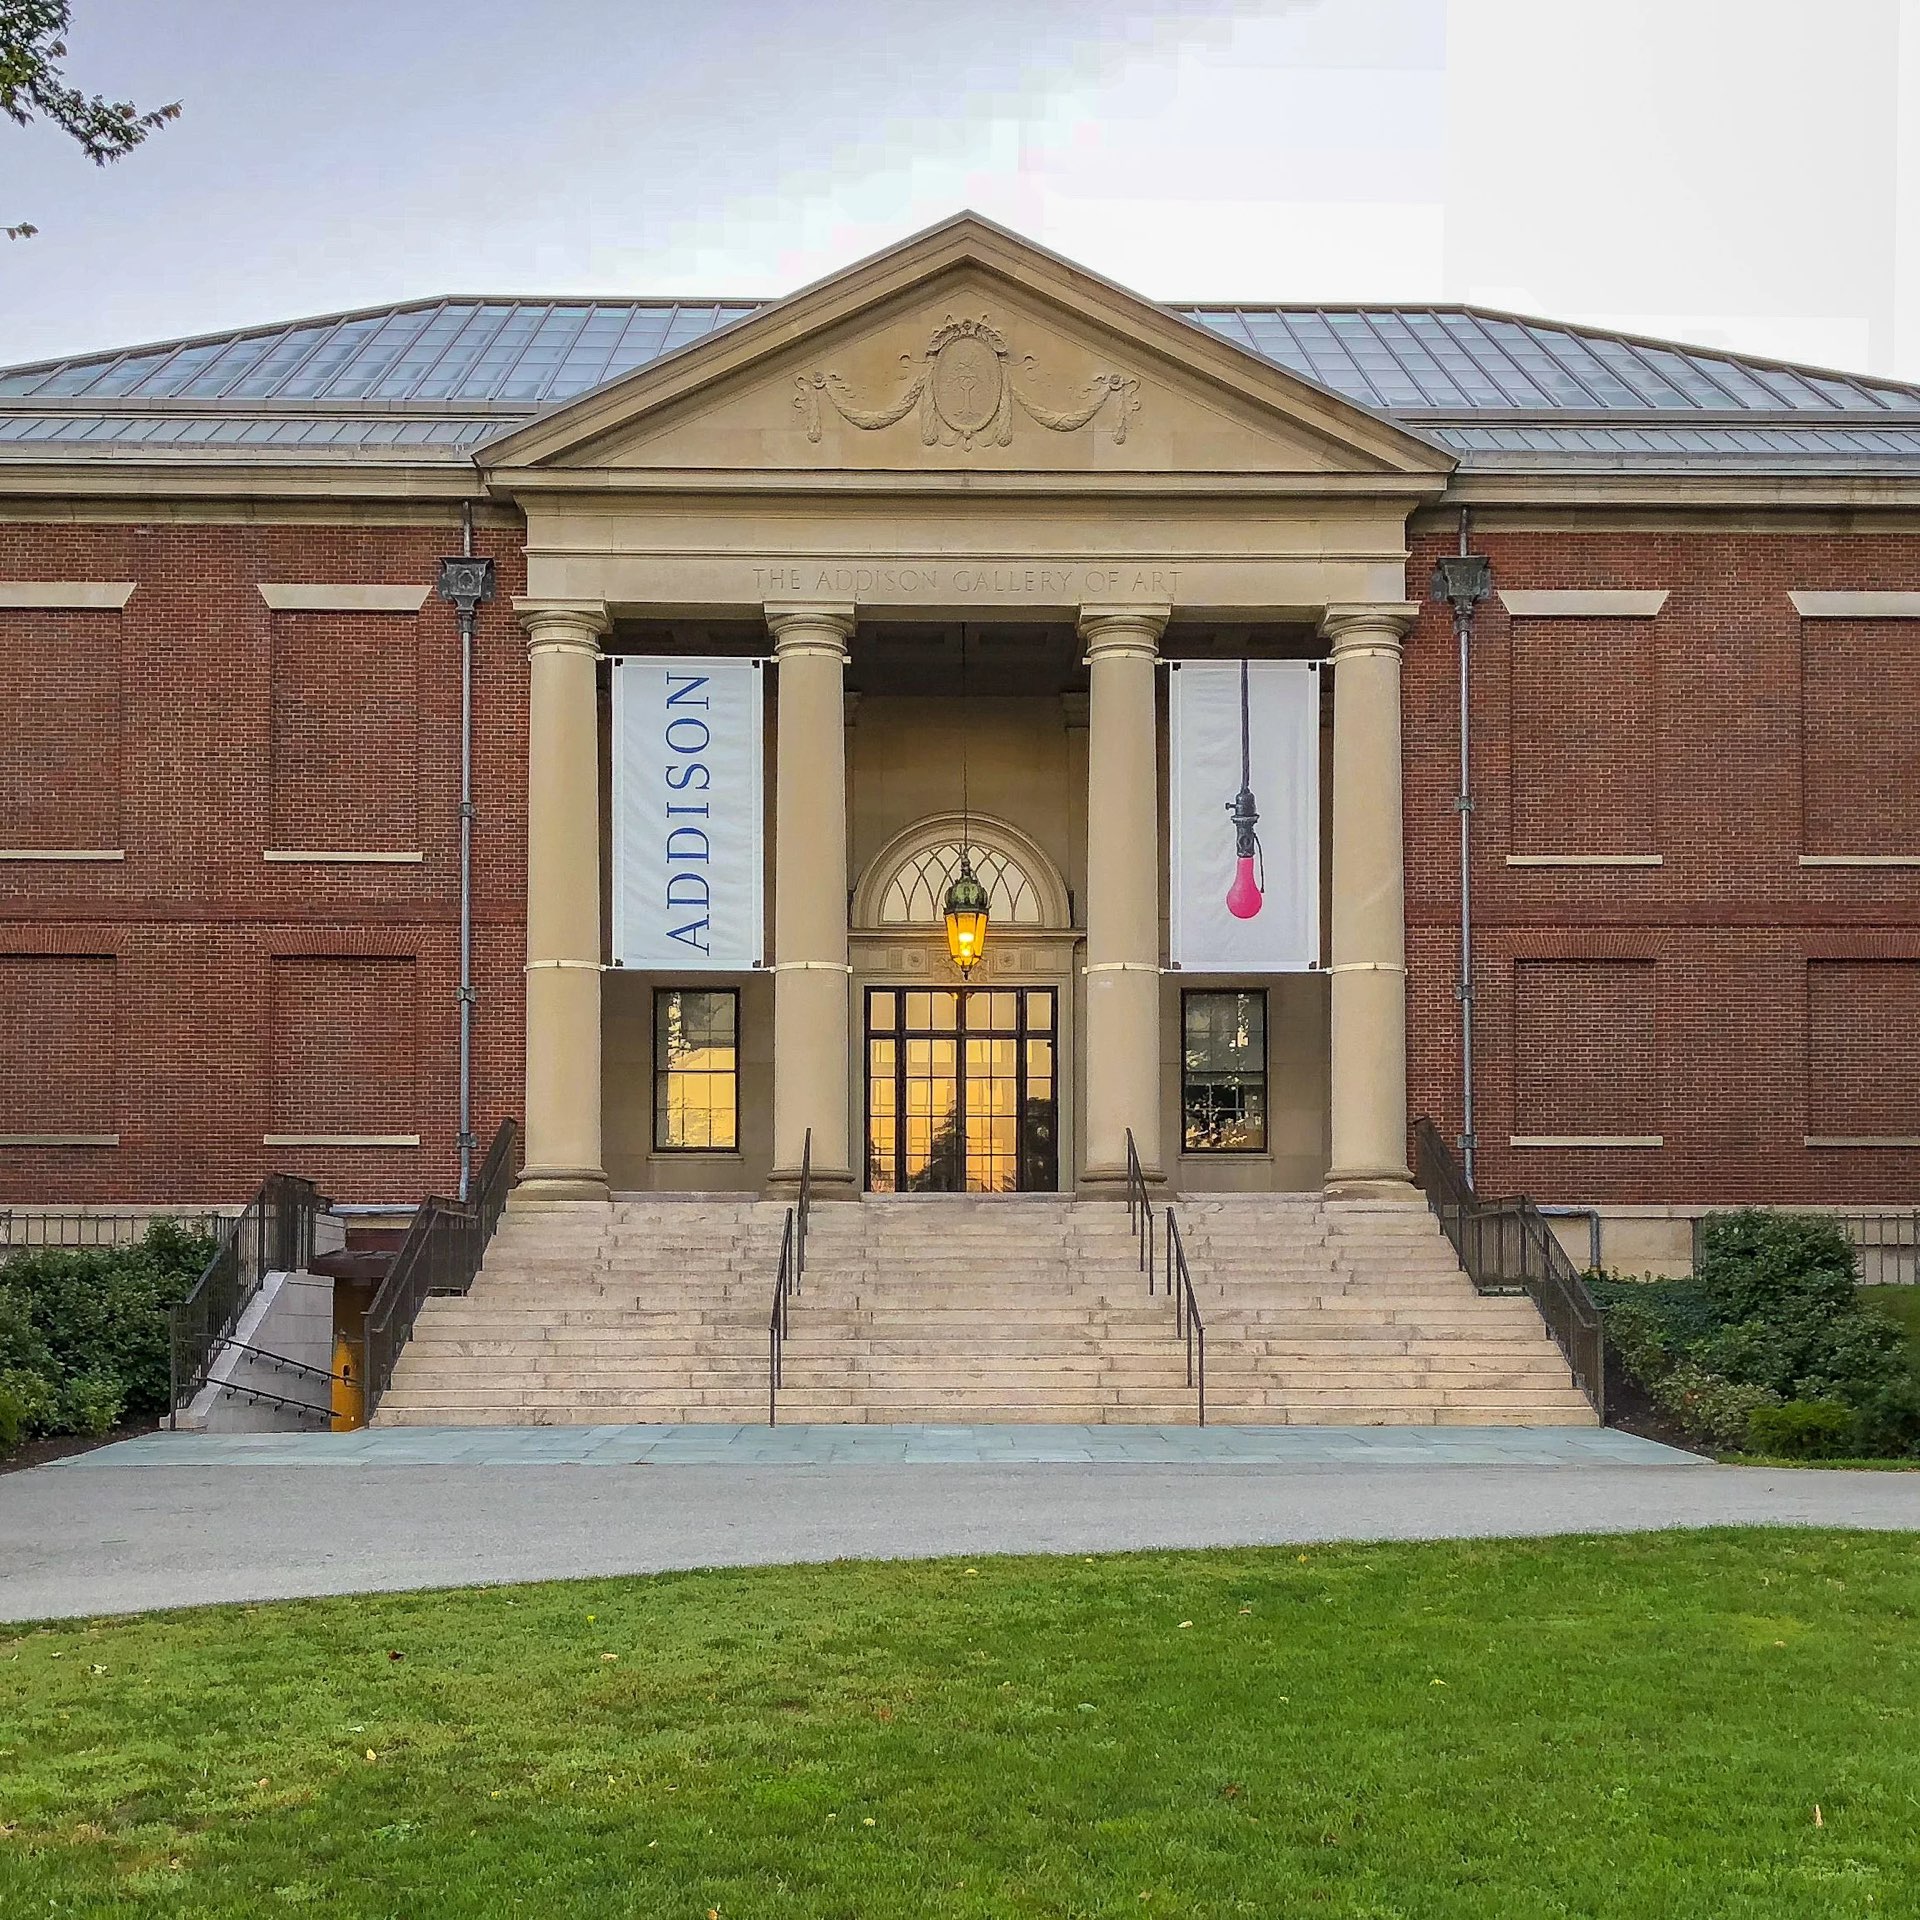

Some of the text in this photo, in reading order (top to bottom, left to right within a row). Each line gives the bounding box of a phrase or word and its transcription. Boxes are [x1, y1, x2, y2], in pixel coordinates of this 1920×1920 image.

[752, 568, 1183, 593] THE ADDISON GALLERY OF ART
[665, 671, 710, 957] ADDISON
